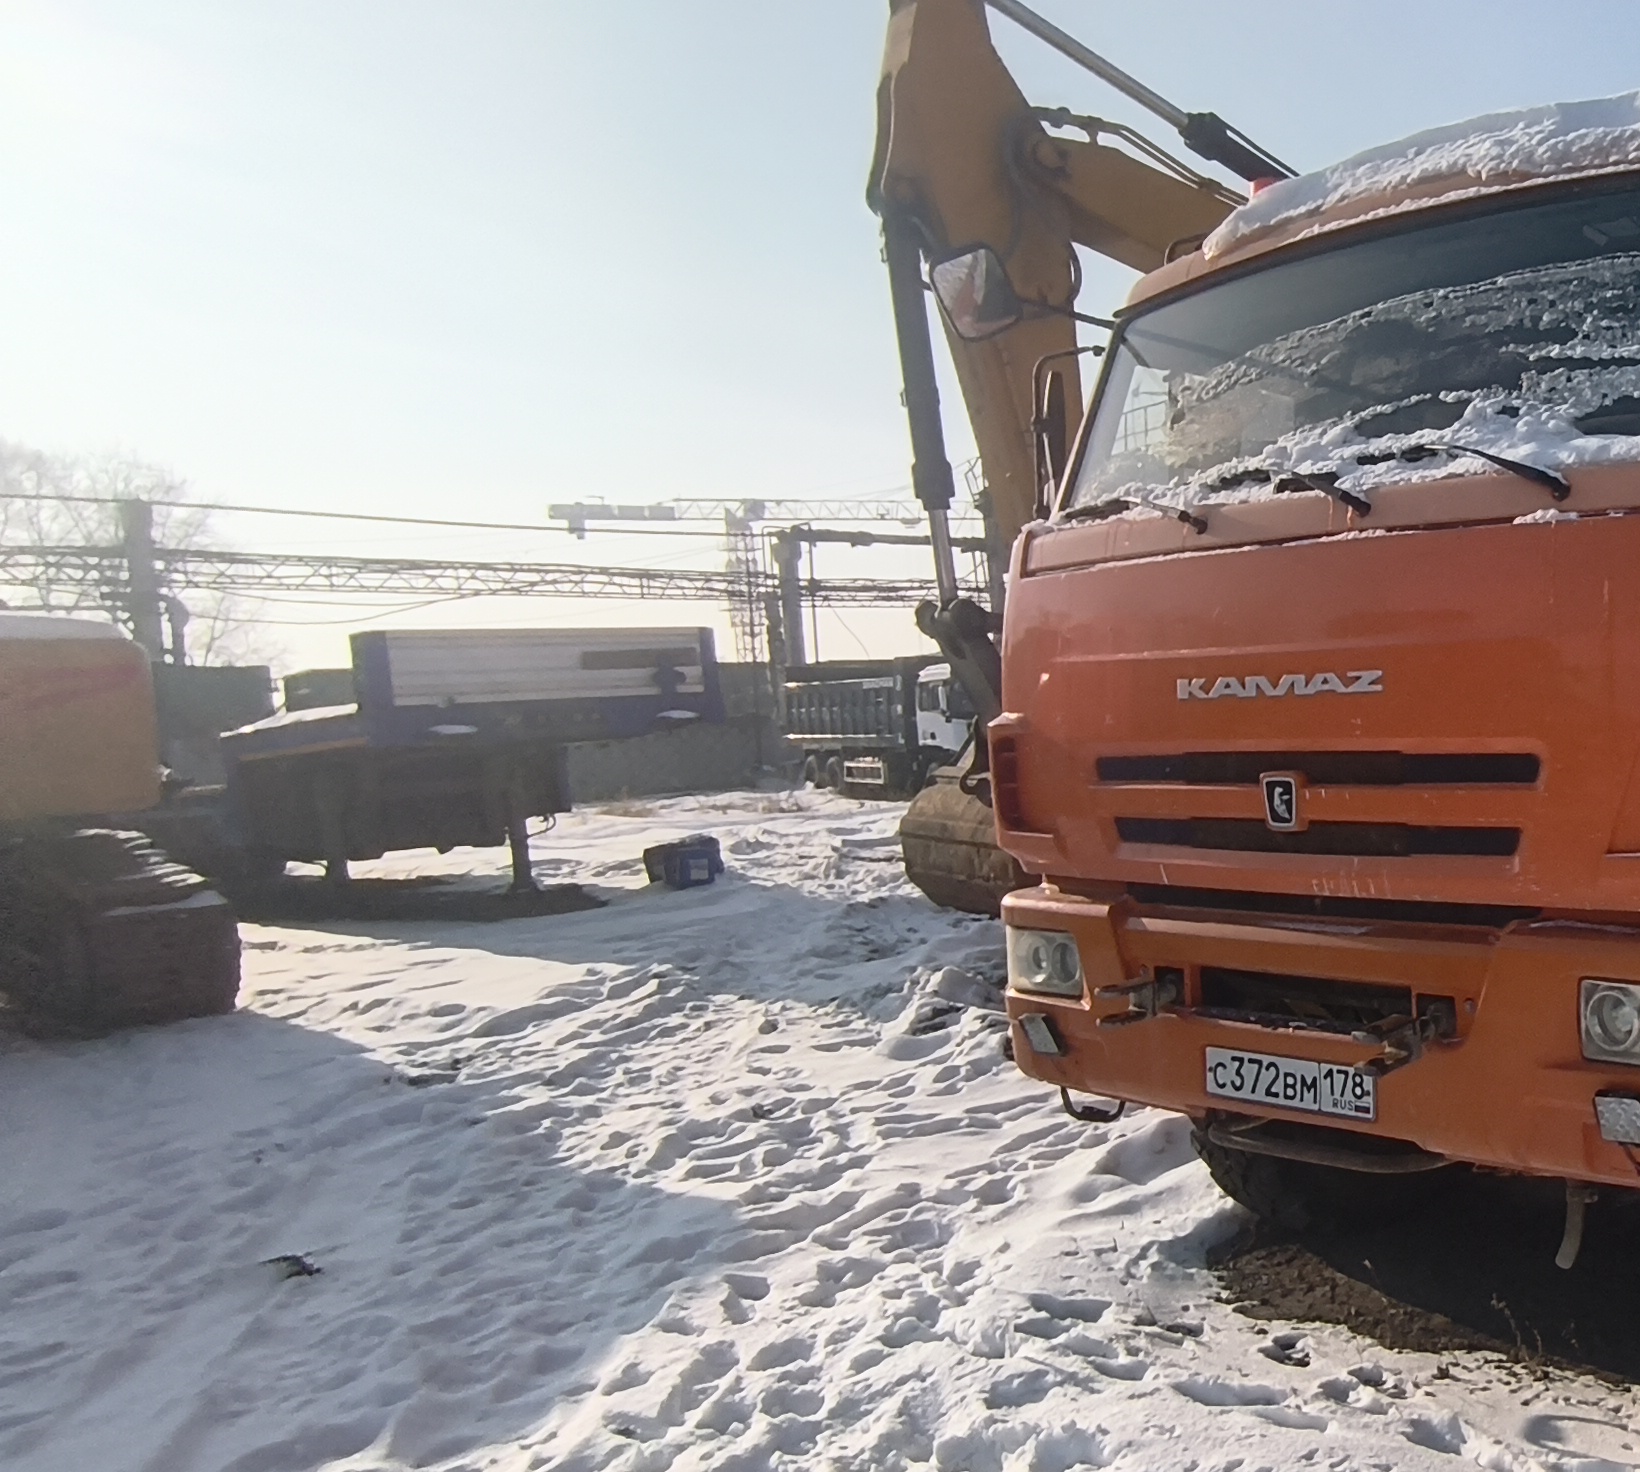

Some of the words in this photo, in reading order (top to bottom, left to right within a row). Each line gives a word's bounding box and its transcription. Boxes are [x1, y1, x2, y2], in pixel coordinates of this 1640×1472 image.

[1177, 670, 1383, 699] KAMAZ
[1212, 1055, 1318, 1105] С372ВМ
[1323, 1067, 1365, 1100] 178
[1332, 1097, 1354, 1112] RUS
